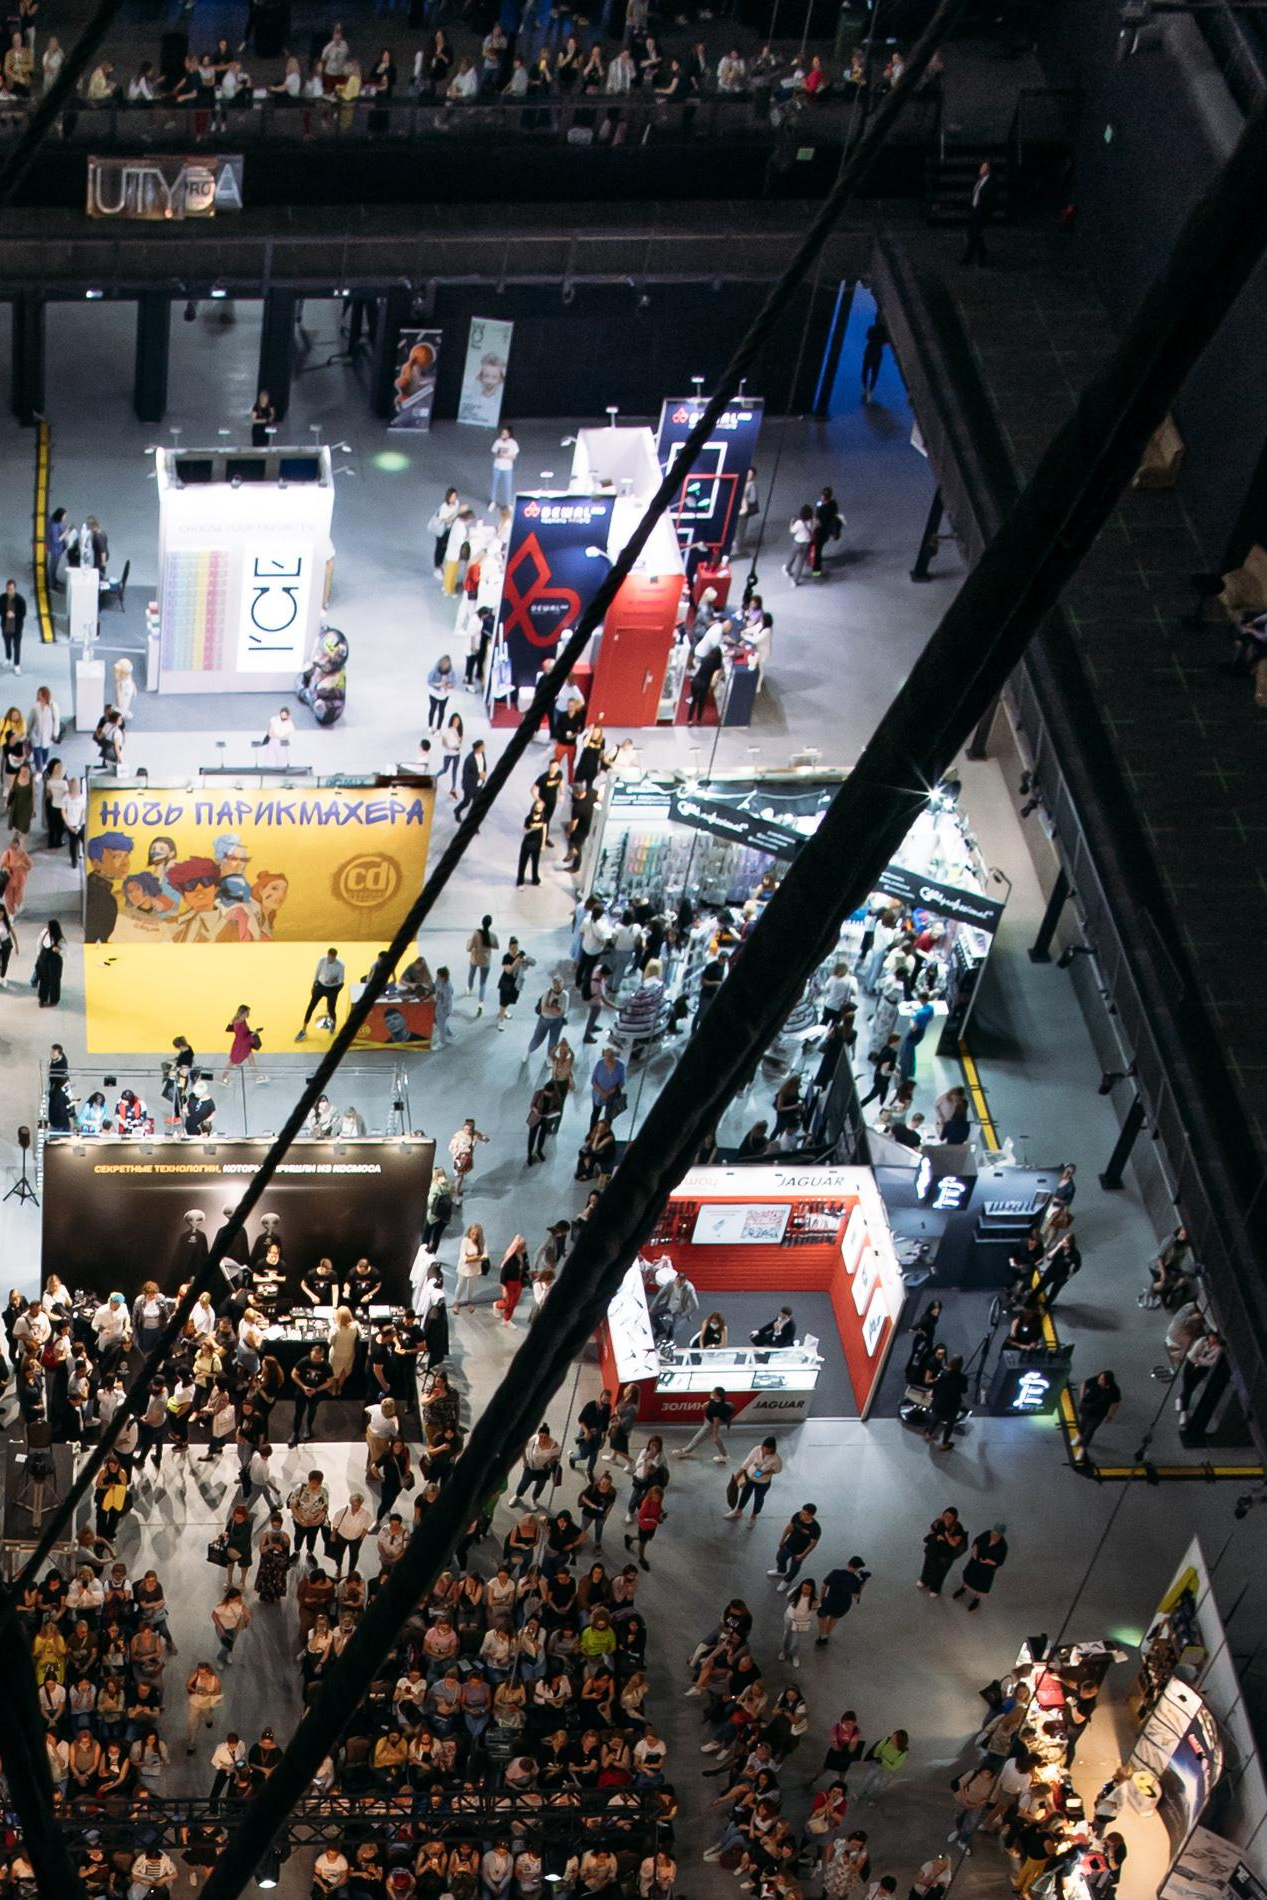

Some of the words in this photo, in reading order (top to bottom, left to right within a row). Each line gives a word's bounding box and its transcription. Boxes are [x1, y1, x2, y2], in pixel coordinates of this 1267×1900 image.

[196, 798, 425, 826] ПАРИКМАХЕРА
[347, 861, 390, 891] cd
[94, 1164, 153, 1174] СЕКРЕТНЫЕ
[332, 1164, 382, 1174] КОСМОСА
[778, 1176, 846, 1188] JAGUAR
[753, 1400, 806, 1409] JAGUAR
